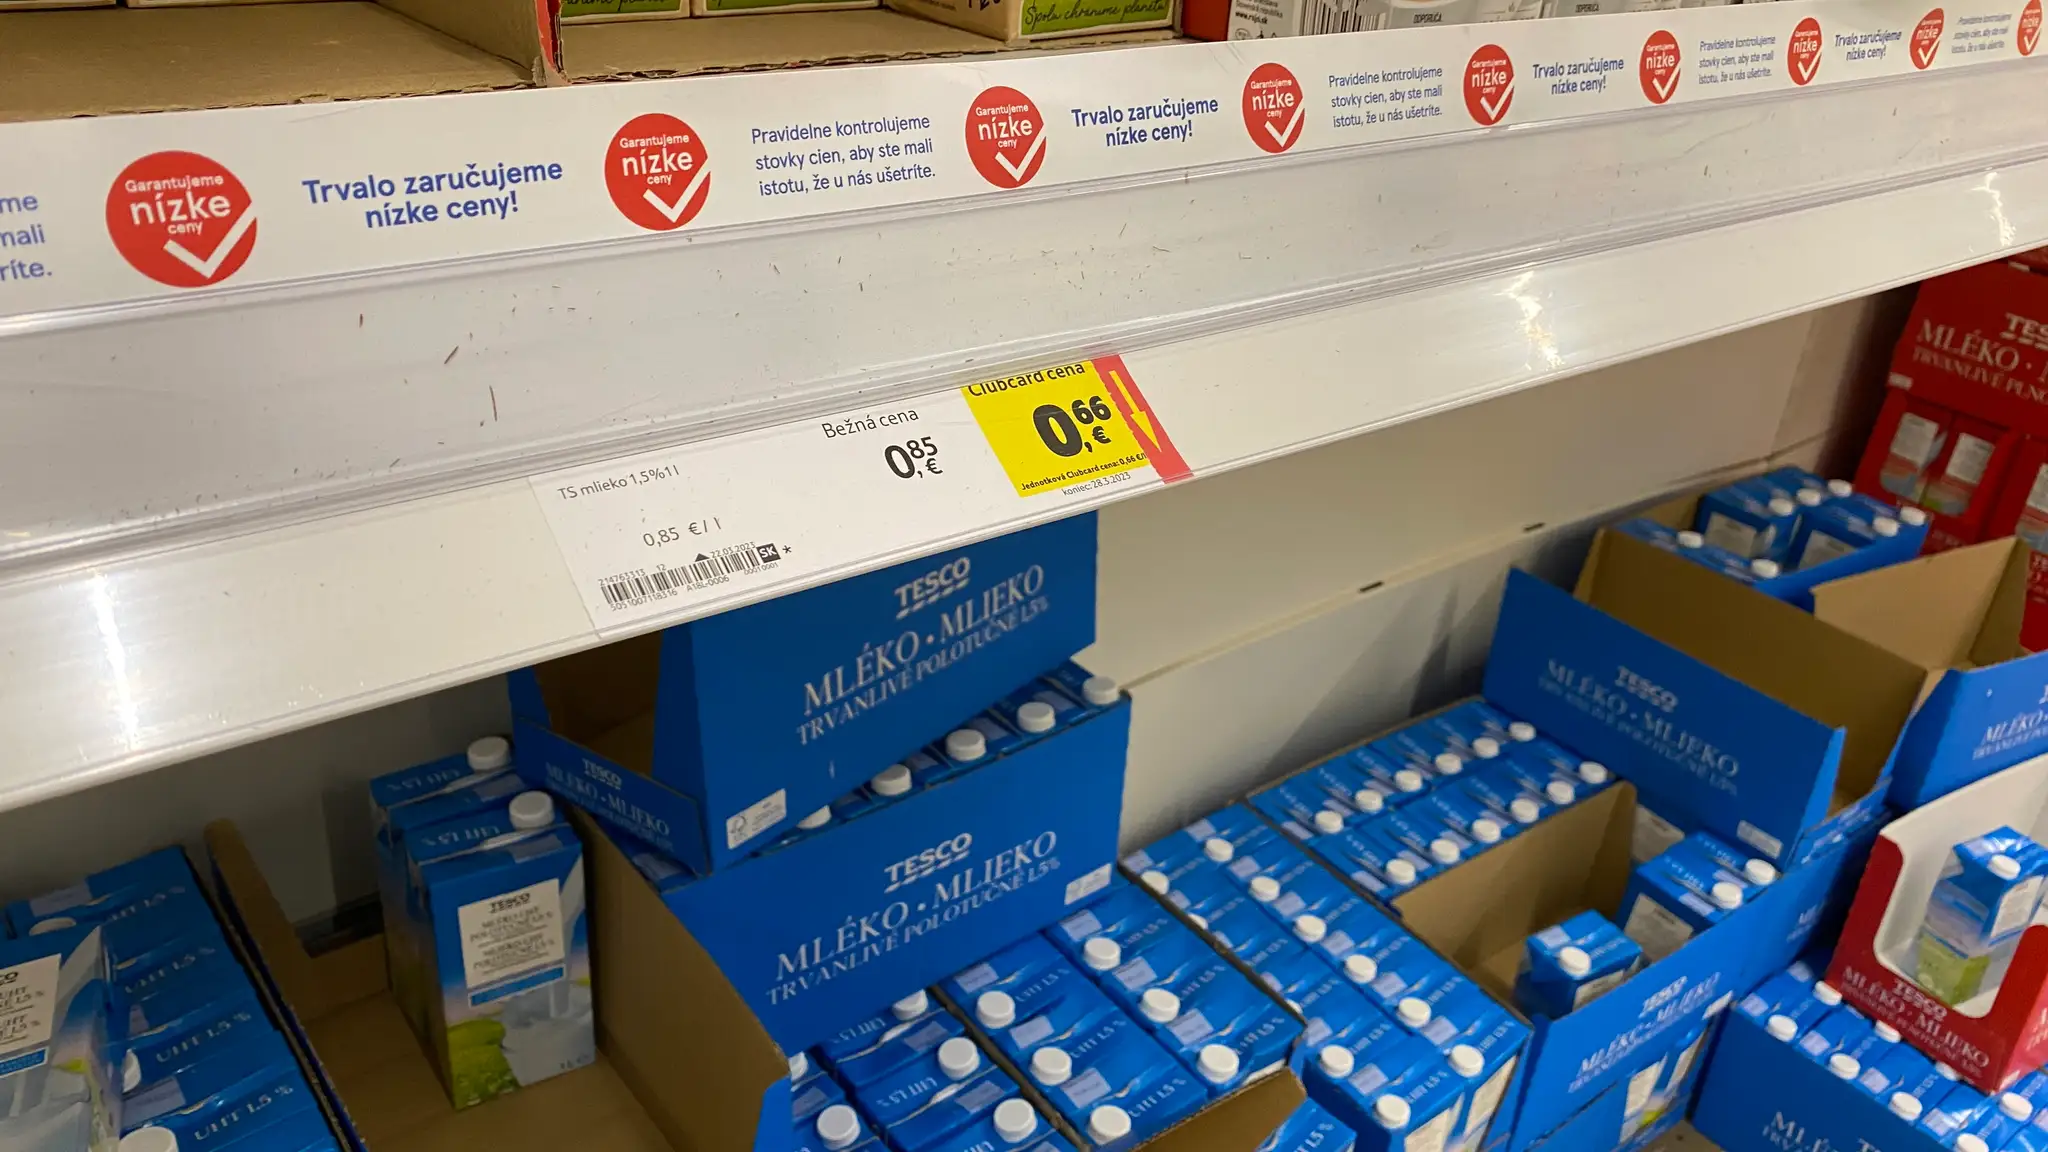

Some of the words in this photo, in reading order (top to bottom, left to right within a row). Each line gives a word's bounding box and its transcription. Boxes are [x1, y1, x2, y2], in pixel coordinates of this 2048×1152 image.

[1699, 39, 1734, 51] Pravidelne
[1793, 37, 1818, 54] nízke
[1835, 32, 1859, 48] Trvalo
[1859, 28, 1902, 45] zaručujeme
[1645, 51, 1675, 70] nízke
[1699, 56, 1720, 69] stovky
[1738, 53, 1749, 66] aby
[1846, 47, 1867, 61] nízke
[1867, 46, 1887, 61] ceny!
[1328, 71, 1380, 89] Pravidelne
[1381, 64, 1443, 83] kontrolujeme
[1471, 66, 1508, 88] nízke
[1532, 62, 1566, 80] Trvalo
[1566, 56, 1625, 77] zaručujeme
[1729, 73, 1734, 81] u
[1250, 77, 1293, 90] Garantujeme
[1331, 92, 1362, 109] stovky
[1364, 90, 1387, 105] cien,
[1389, 88, 1406, 104] aby
[1407, 87, 1422, 101] ste
[1423, 84, 1443, 99] mali
[1550, 78, 1578, 96] nízke
[1579, 75, 1607, 94] ceny!
[975, 103, 1030, 118] Garantujeme
[1071, 105, 1124, 128] Trvalo
[1127, 97, 1219, 123] zaručujeme
[1252, 88, 1295, 112] nízke
[1266, 107, 1283, 119] ceny
[751, 123, 833, 145] Pravidelne
[834, 115, 931, 138] kontrolujeme
[977, 115, 1033, 141] nízke
[1333, 113, 1365, 129] istotu,
[1366, 109, 1378, 125] že
[1379, 112, 1385, 123] u
[1387, 106, 1404, 122] nás
[1405, 103, 1443, 119] ušetríte.
[619, 132, 690, 150] Garantujeme
[997, 138, 1018, 150] ceny
[1105, 123, 1148, 148] nízke
[1151, 119, 1193, 144] ceny!
[621, 147, 694, 178] nízke
[755, 152, 805, 172] stovky
[808, 148, 846, 167] cien,
[849, 145, 876, 164] aby
[878, 141, 901, 158] ste
[903, 138, 934, 156] mali
[124, 174, 224, 194] Garantujeme
[302, 174, 396, 205] Trvalo
[403, 161, 564, 196] zaručujeme
[646, 174, 673, 187] ceny
[759, 179, 809, 197] istotu,
[812, 173, 831, 191] že
[834, 176, 845, 189] u
[847, 169, 873, 186] nás
[876, 164, 936, 184] ušetríte.
[129, 190, 232, 226] nízke
[364, 199, 439, 229] nízke
[446, 189, 520, 220] ceny!
[167, 220, 204, 237] ceny
[1915, 318, 2020, 372] MLÉKO
[968, 371, 1045, 397] Clubcard
[1049, 363, 1086, 381] cena
[821, 414, 878, 438] Bežná
[879, 410, 919, 427] cena
[1020, 472, 1066, 491] Jednotková
[1066, 464, 1101, 480] Clubcard
[1100, 459, 1120, 471] cena:
[1118, 454, 1136, 466] 0,66
[557, 485, 578, 500] TS
[580, 475, 628, 497] mlieko
[642, 526, 680, 548] 0,85
[655, 563, 667, 573] 12
[710, 541, 757, 559] 22.03.2023
[758, 546, 778, 559] SK
[893, 556, 971, 609] TESCO
[803, 630, 920, 717] MLÉKO
[939, 563, 1045, 644] MLIEKO
[1614, 665, 1679, 709] TESCO
[796, 660, 914, 746] TRVANLIVÉ
[1644, 711, 1740, 778] MLIEKO
[582, 757, 623, 788] TESCO
[884, 832, 973, 884] TESCO
[775, 901, 910, 983] MLÉKO
[931, 830, 1058, 910] MLIEKO
[766, 927, 900, 1006] TRVANLIVÉ
[1894, 978, 1948, 1020] TESCO
[156, 1035, 201, 1064] UHT
[1916, 1012, 1990, 1069] MLIEKO
[194, 1108, 241, 1141] UHT
